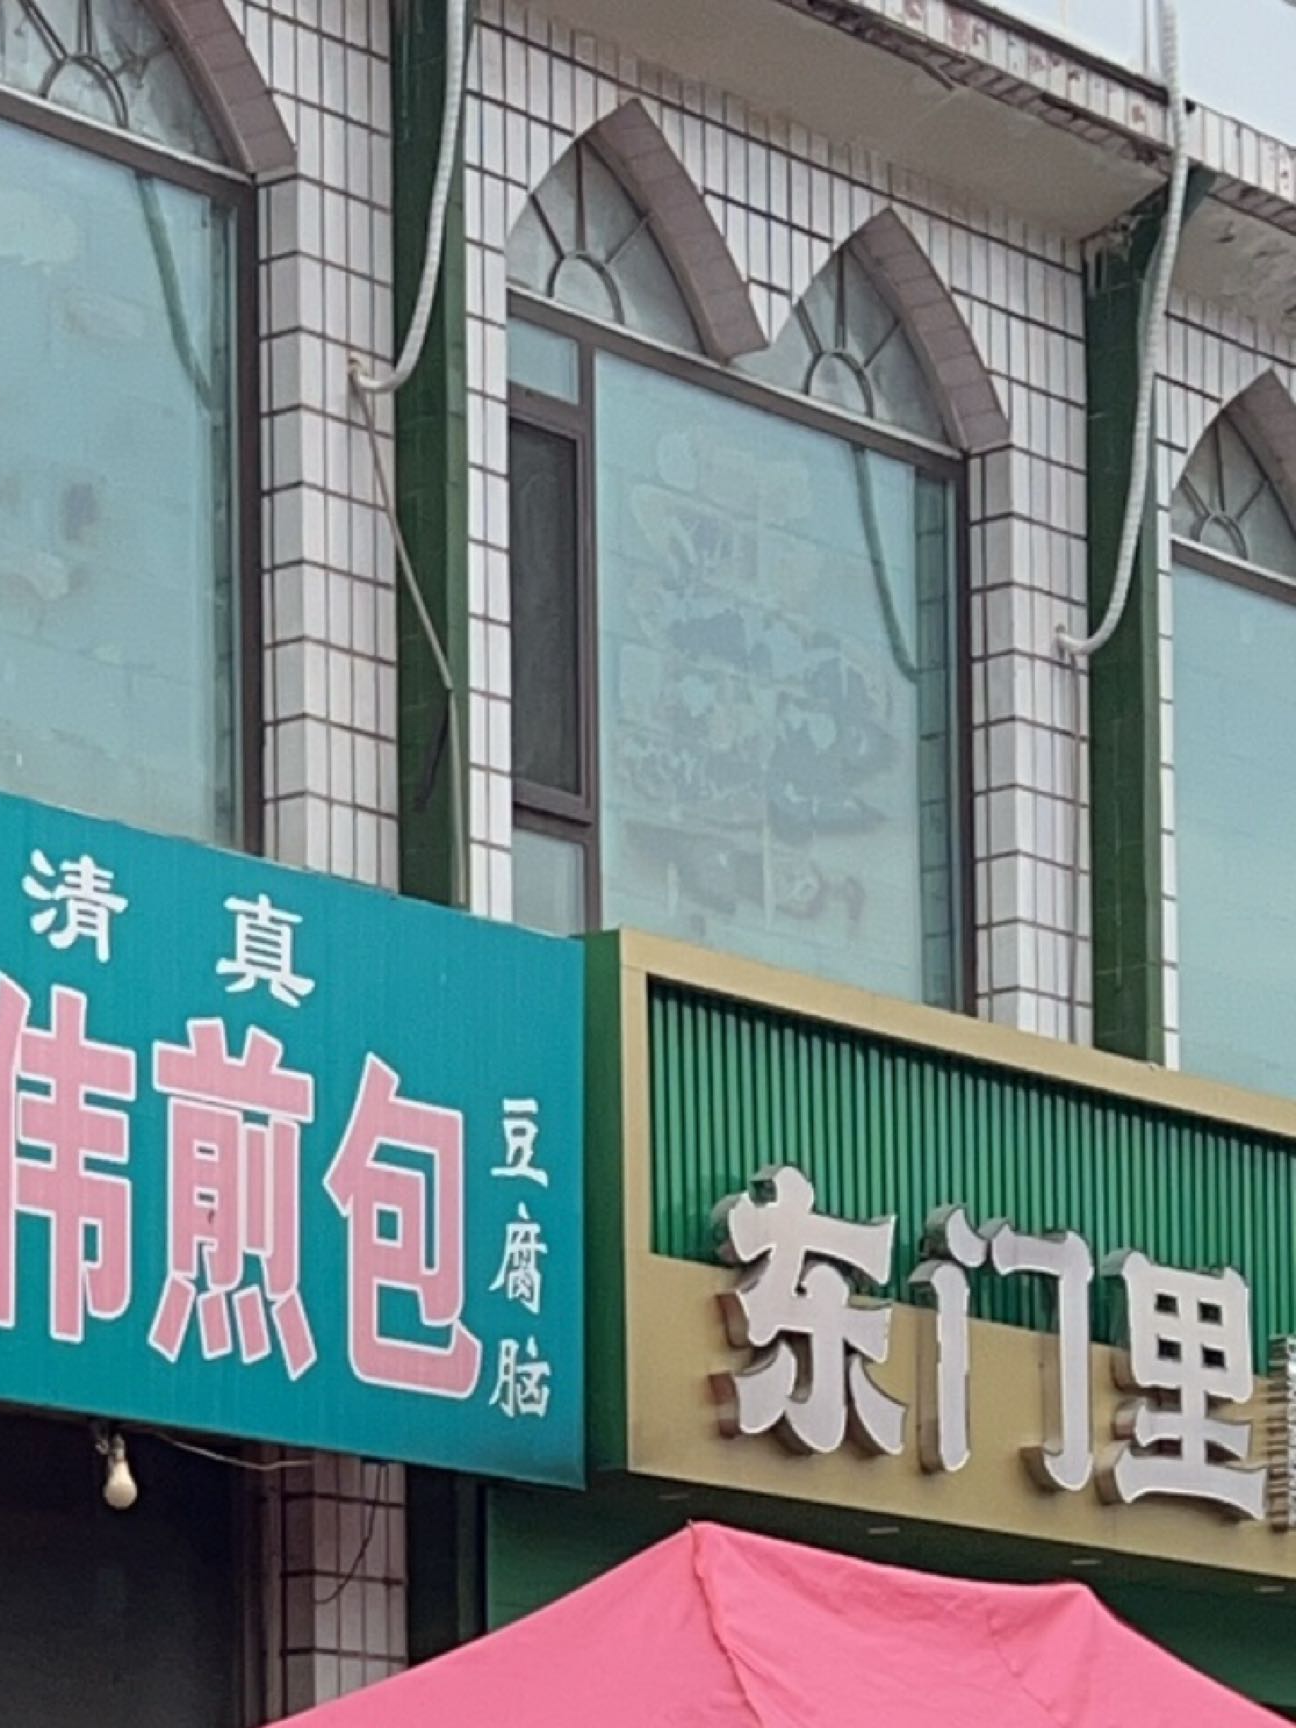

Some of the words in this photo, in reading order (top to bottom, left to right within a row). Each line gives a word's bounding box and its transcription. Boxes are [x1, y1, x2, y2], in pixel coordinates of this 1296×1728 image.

[21, 848, 315, 1008] 清真
[488, 1098, 553, 1417] 豆腐脑
[712, 1163, 1267, 1521] 东门里
